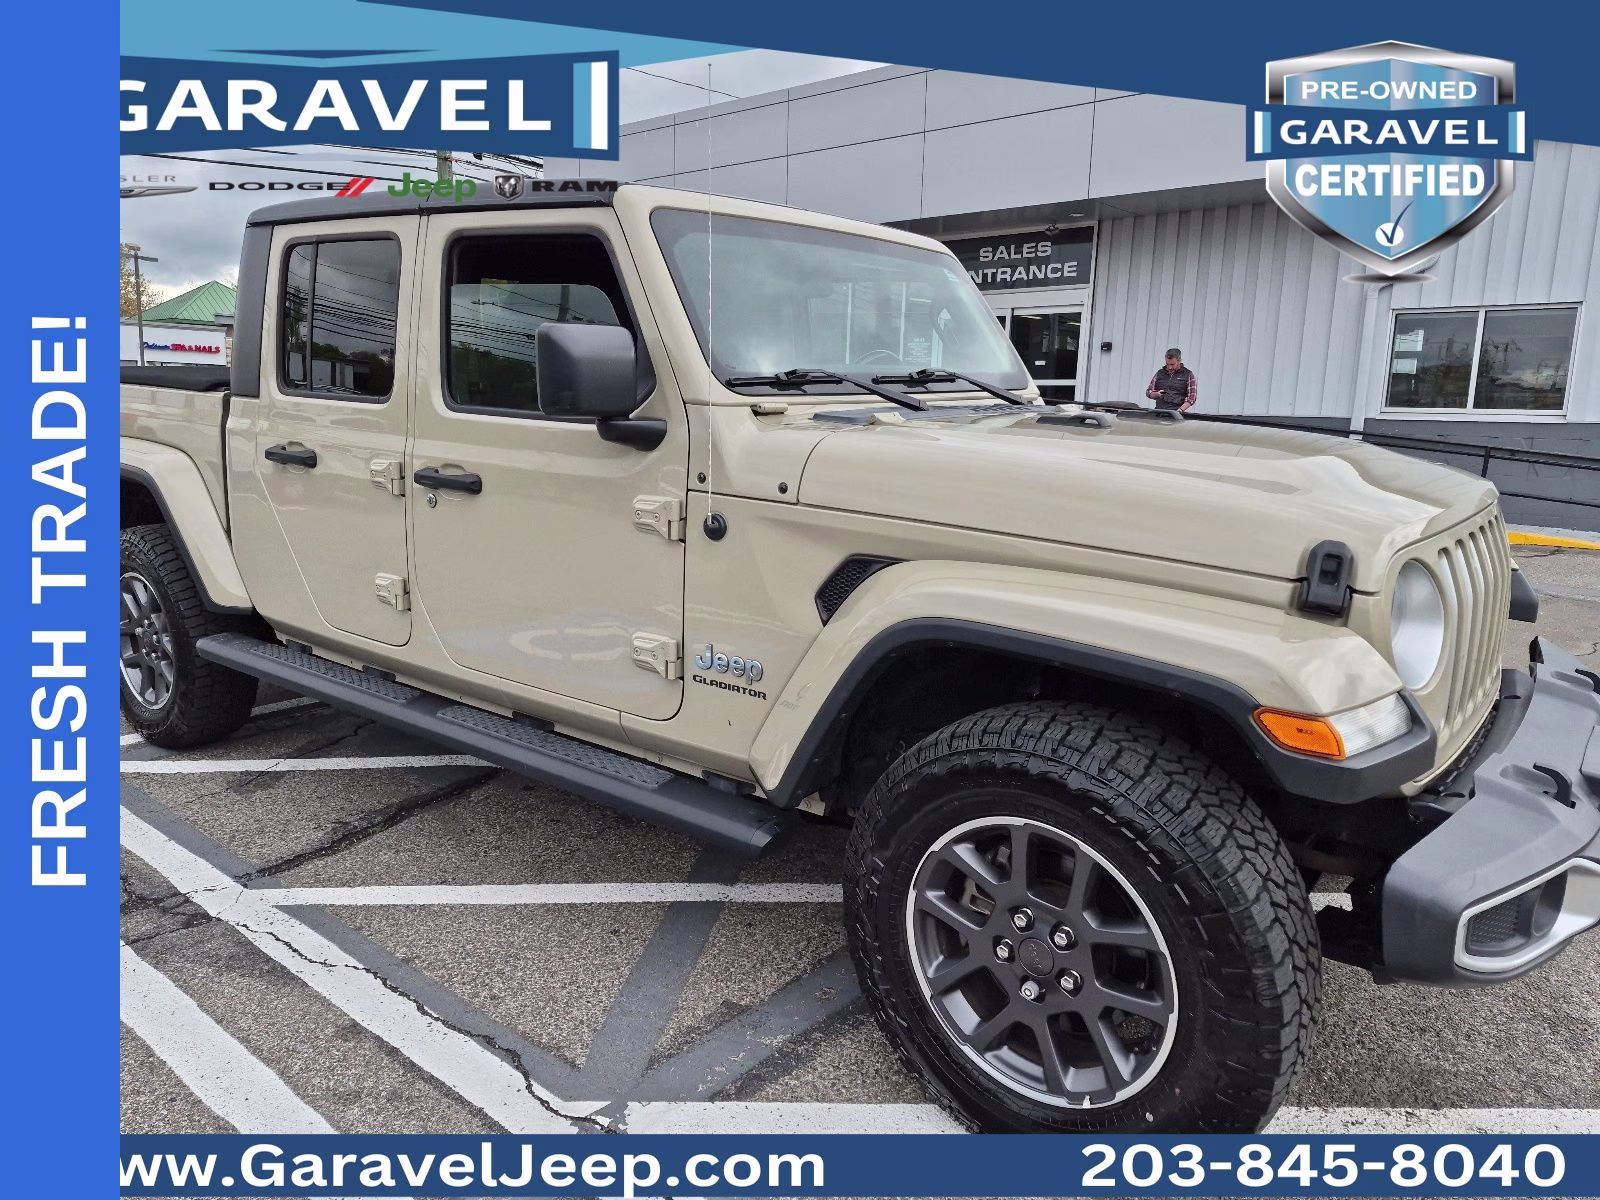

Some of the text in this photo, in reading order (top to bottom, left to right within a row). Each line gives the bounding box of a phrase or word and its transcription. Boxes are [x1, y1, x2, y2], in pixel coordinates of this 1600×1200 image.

[979, 241, 1052, 262] SALES
[967, 261, 1078, 284] NTRANCE
[695, 643, 763, 685] Jeep
[692, 674, 767, 700] GLADIATOR
